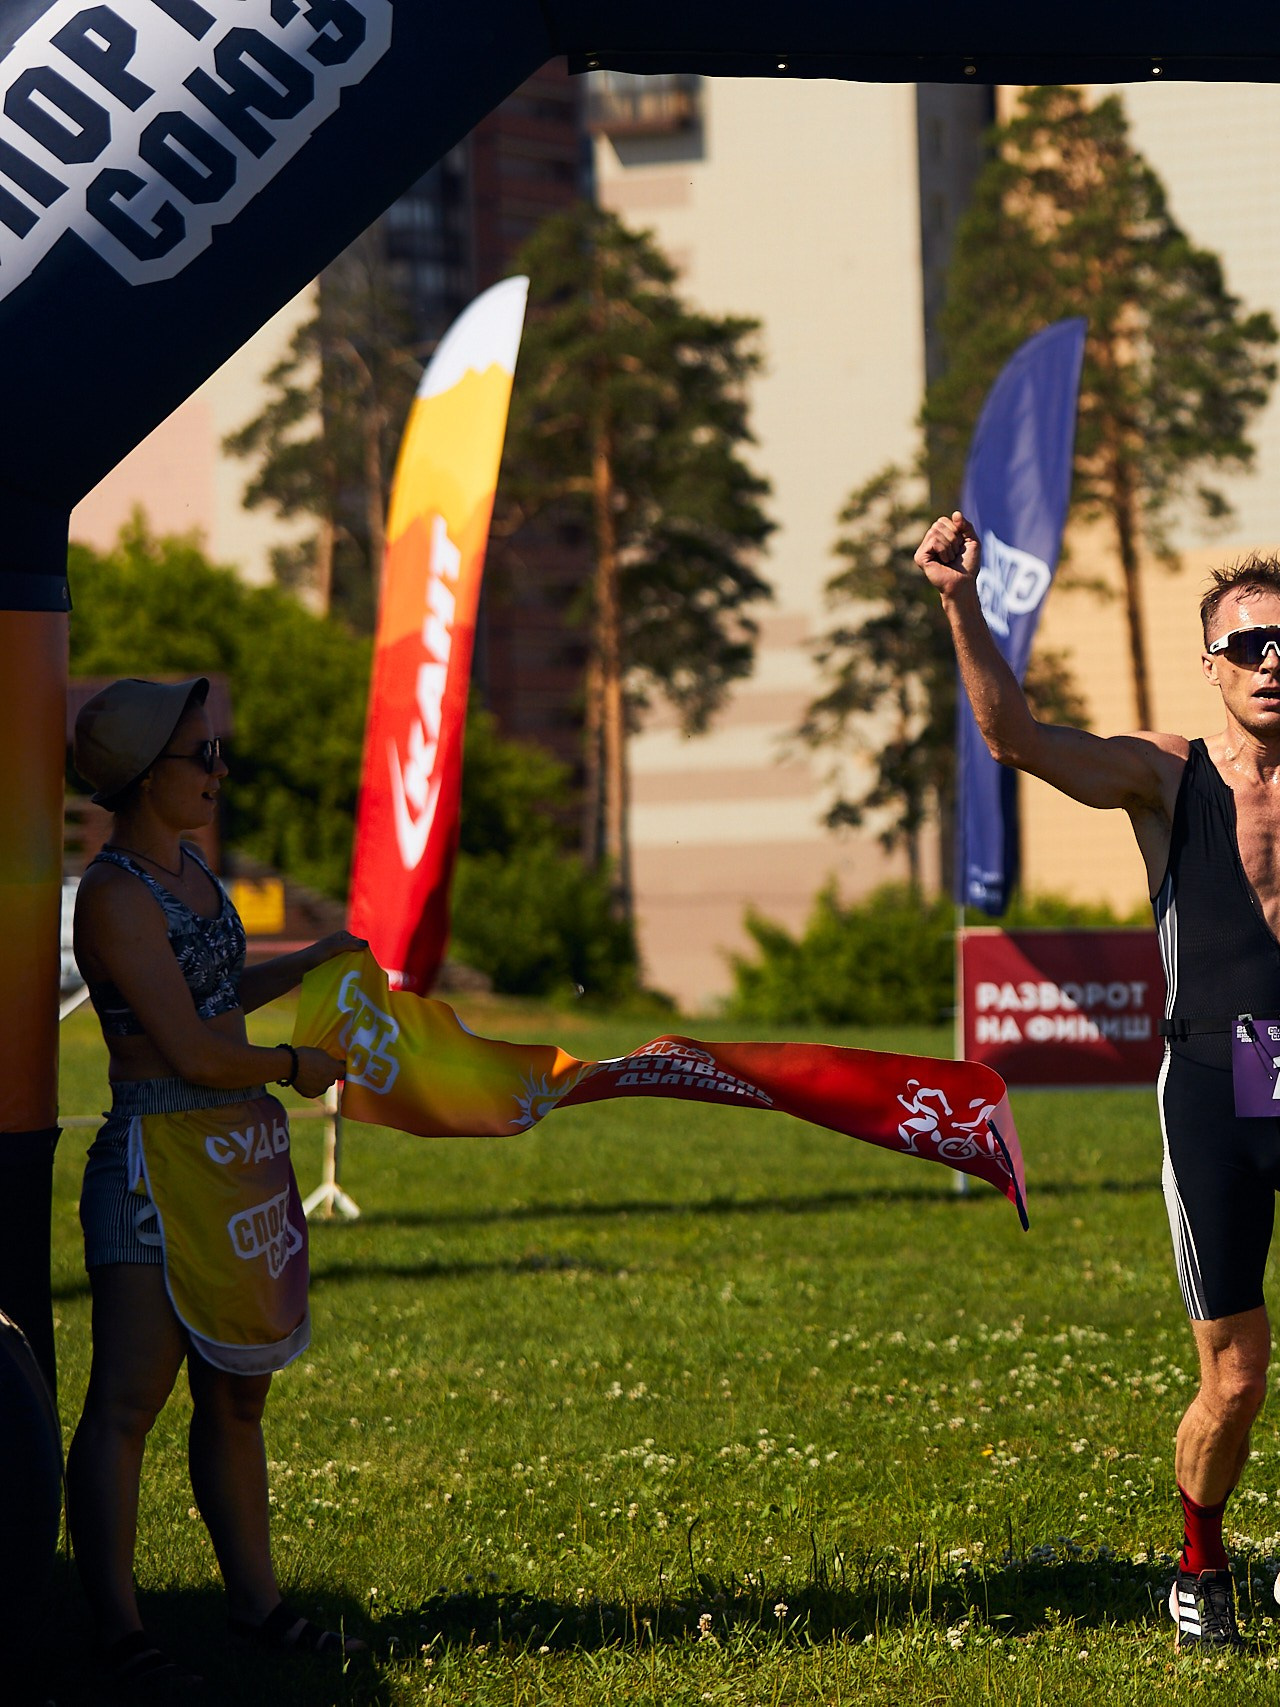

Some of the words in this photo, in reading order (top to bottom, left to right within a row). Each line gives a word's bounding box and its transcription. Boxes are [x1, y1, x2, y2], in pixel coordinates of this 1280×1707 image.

[86, 0, 367, 262] СОЮЗ
[975, 981, 1148, 1012] РАЗВОРОТ
[975, 1014, 1023, 1044] НА
[1024, 1013, 1151, 1043] ФИНИШ
[205, 1118, 289, 1165] СУДЬ
